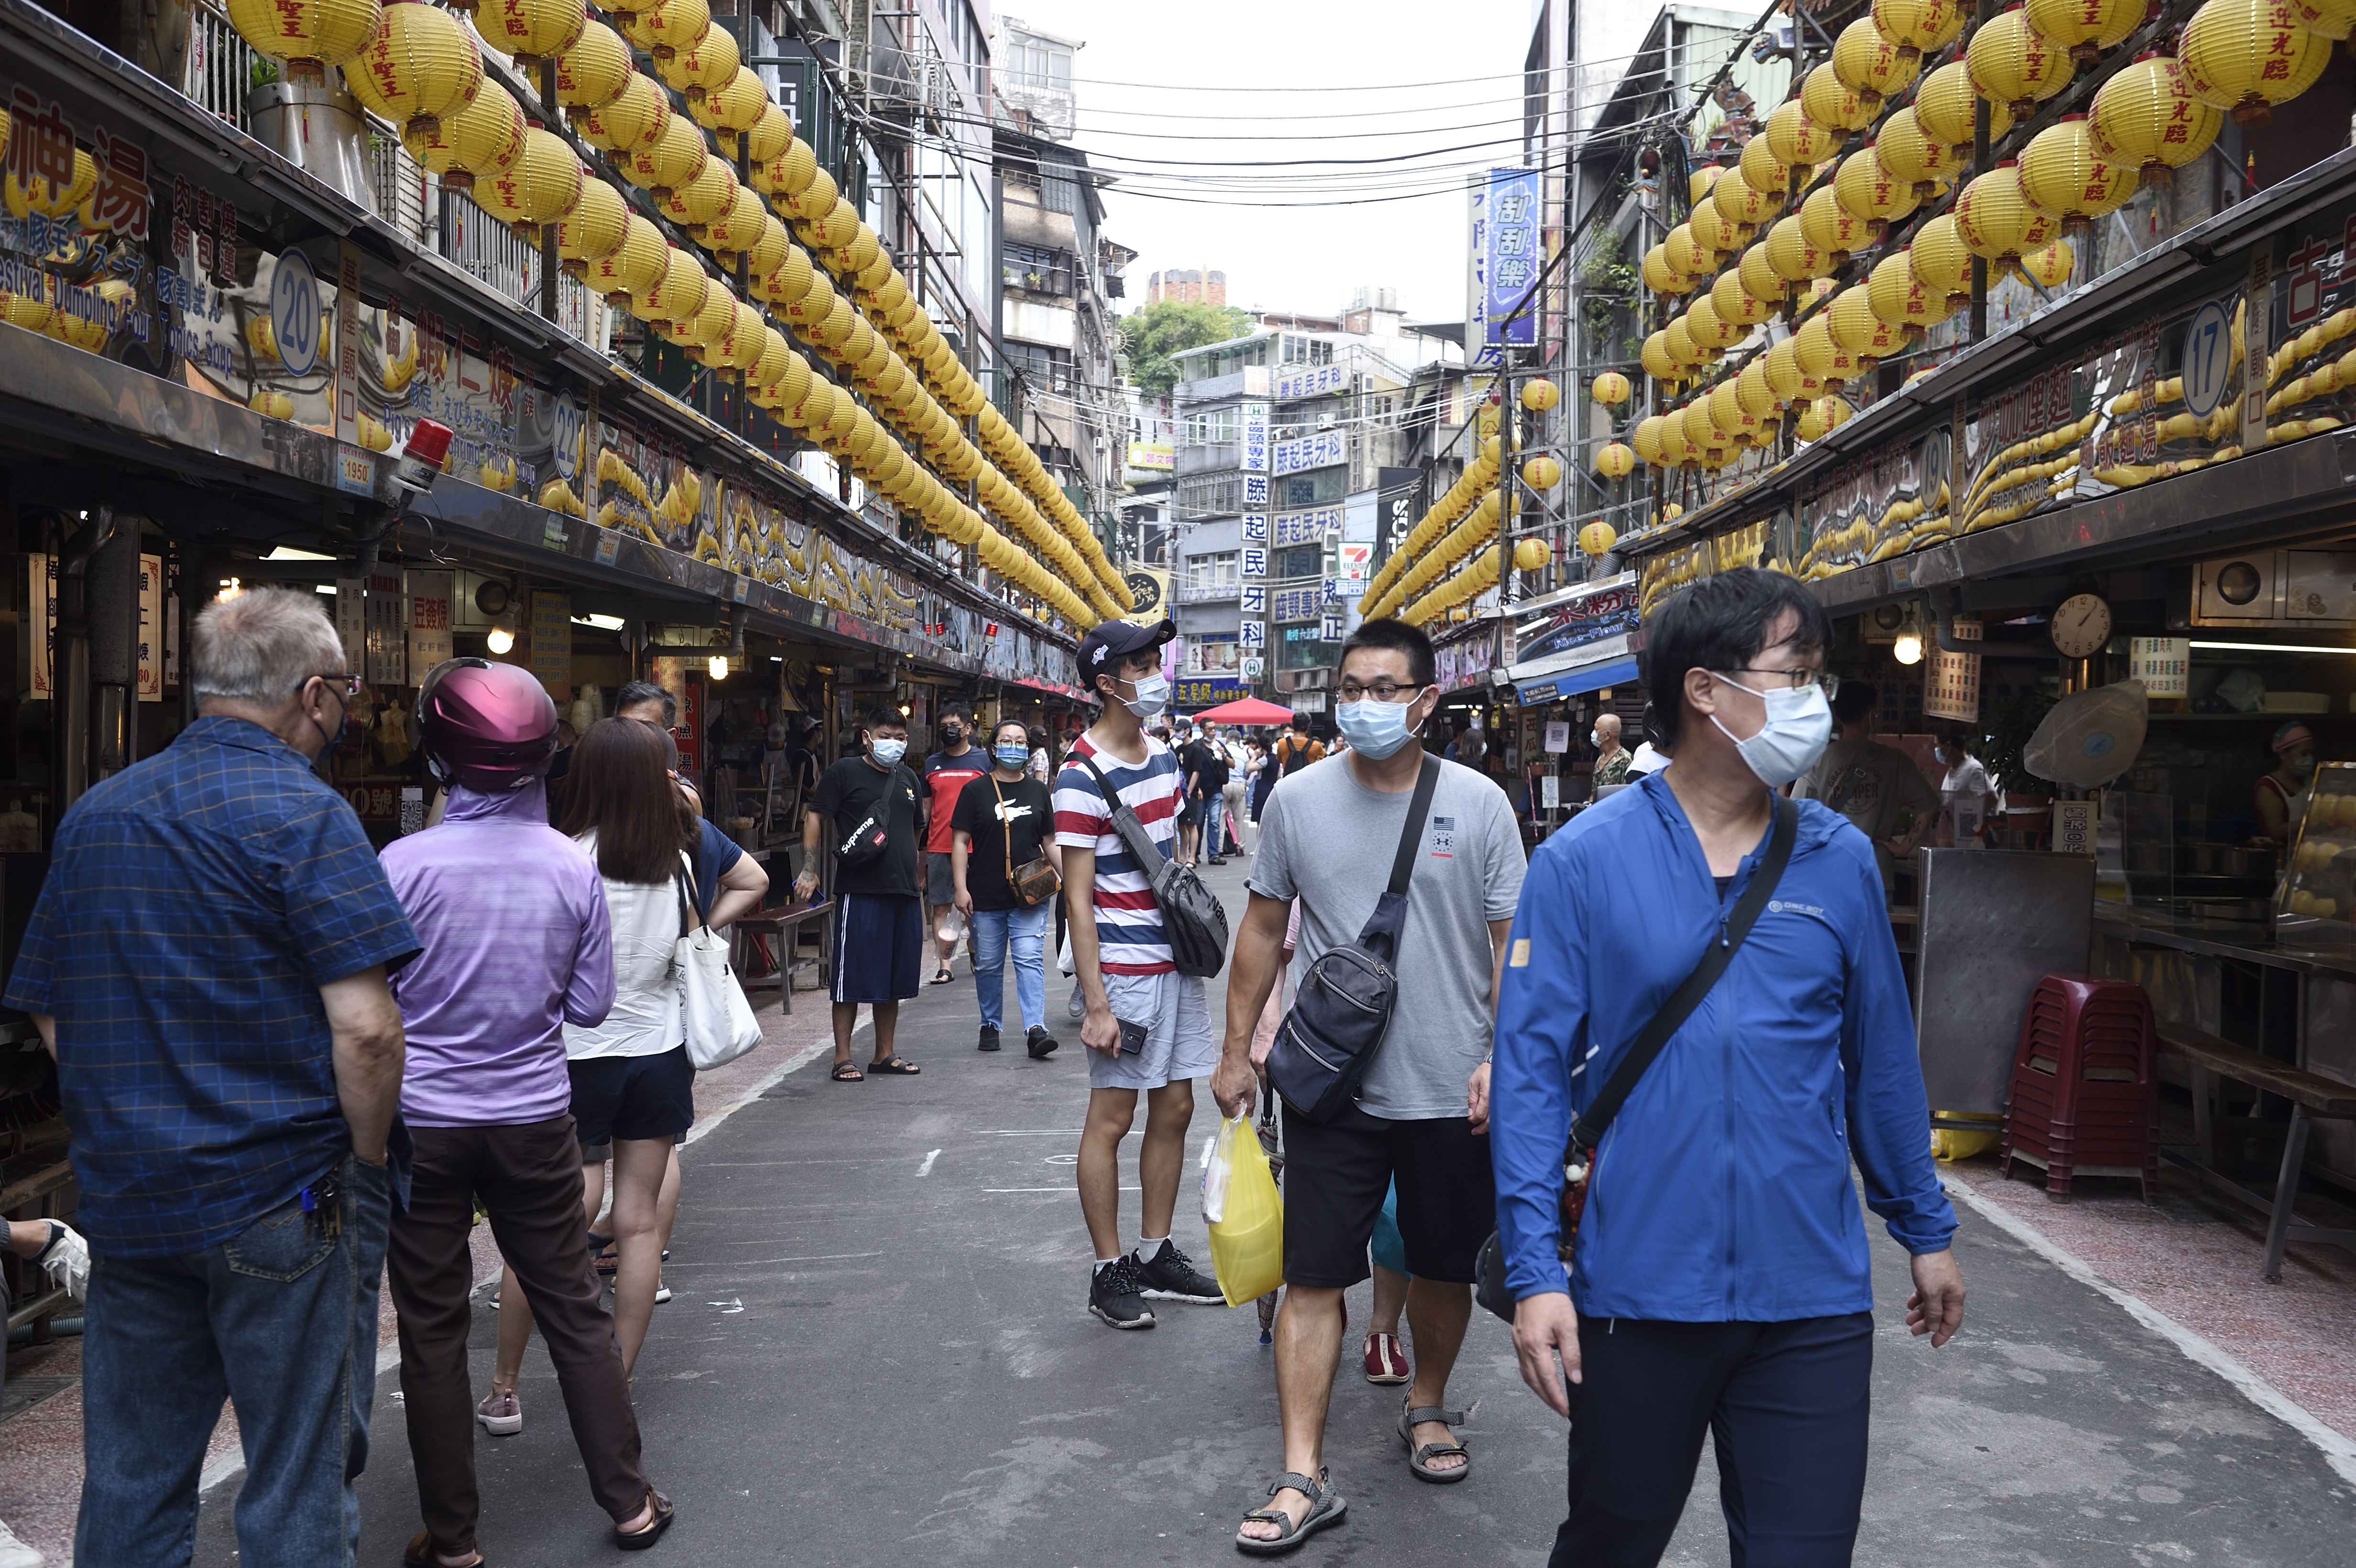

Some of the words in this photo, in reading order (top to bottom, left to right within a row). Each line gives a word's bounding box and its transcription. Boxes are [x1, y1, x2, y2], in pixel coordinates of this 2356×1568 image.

[1497, 195, 1530, 288] 刮刮樂
[282, 270, 311, 355] 20
[205, 330, 233, 380] Soup
[2192, 320, 2219, 399] 17
[2139, 314, 2160, 460] 鮮魚湯
[556, 404, 576, 463] 22
[383, 403, 412, 445] Pig's
[485, 442, 511, 478] Thick
[514, 453, 536, 492] Soup
[347, 460, 367, 481] 1950
[1923, 444, 1940, 492] 19
[1990, 487, 2015, 514] Fried
[2017, 475, 2050, 505] noodle
[602, 541, 613, 555] 1950
[2080, 597, 2087, 605] 12
[2058, 609, 2065, 617] 10
[2101, 609, 2106, 618] 2
[1554, 622, 1623, 649] Rice-Flour
[2052, 621, 2058, 630] 9
[2103, 621, 2108, 630] 3
[2055, 633, 2060, 641] 8
[2065, 642, 2069, 650] 7
[2087, 642, 2092, 650] 5
[2075, 645, 2080, 653] 6
[353, 663, 360, 674] 20
[341, 787, 393, 816] 0號
[841, 817, 874, 854] Supreme
[1806, 904, 1824, 915] BOY
